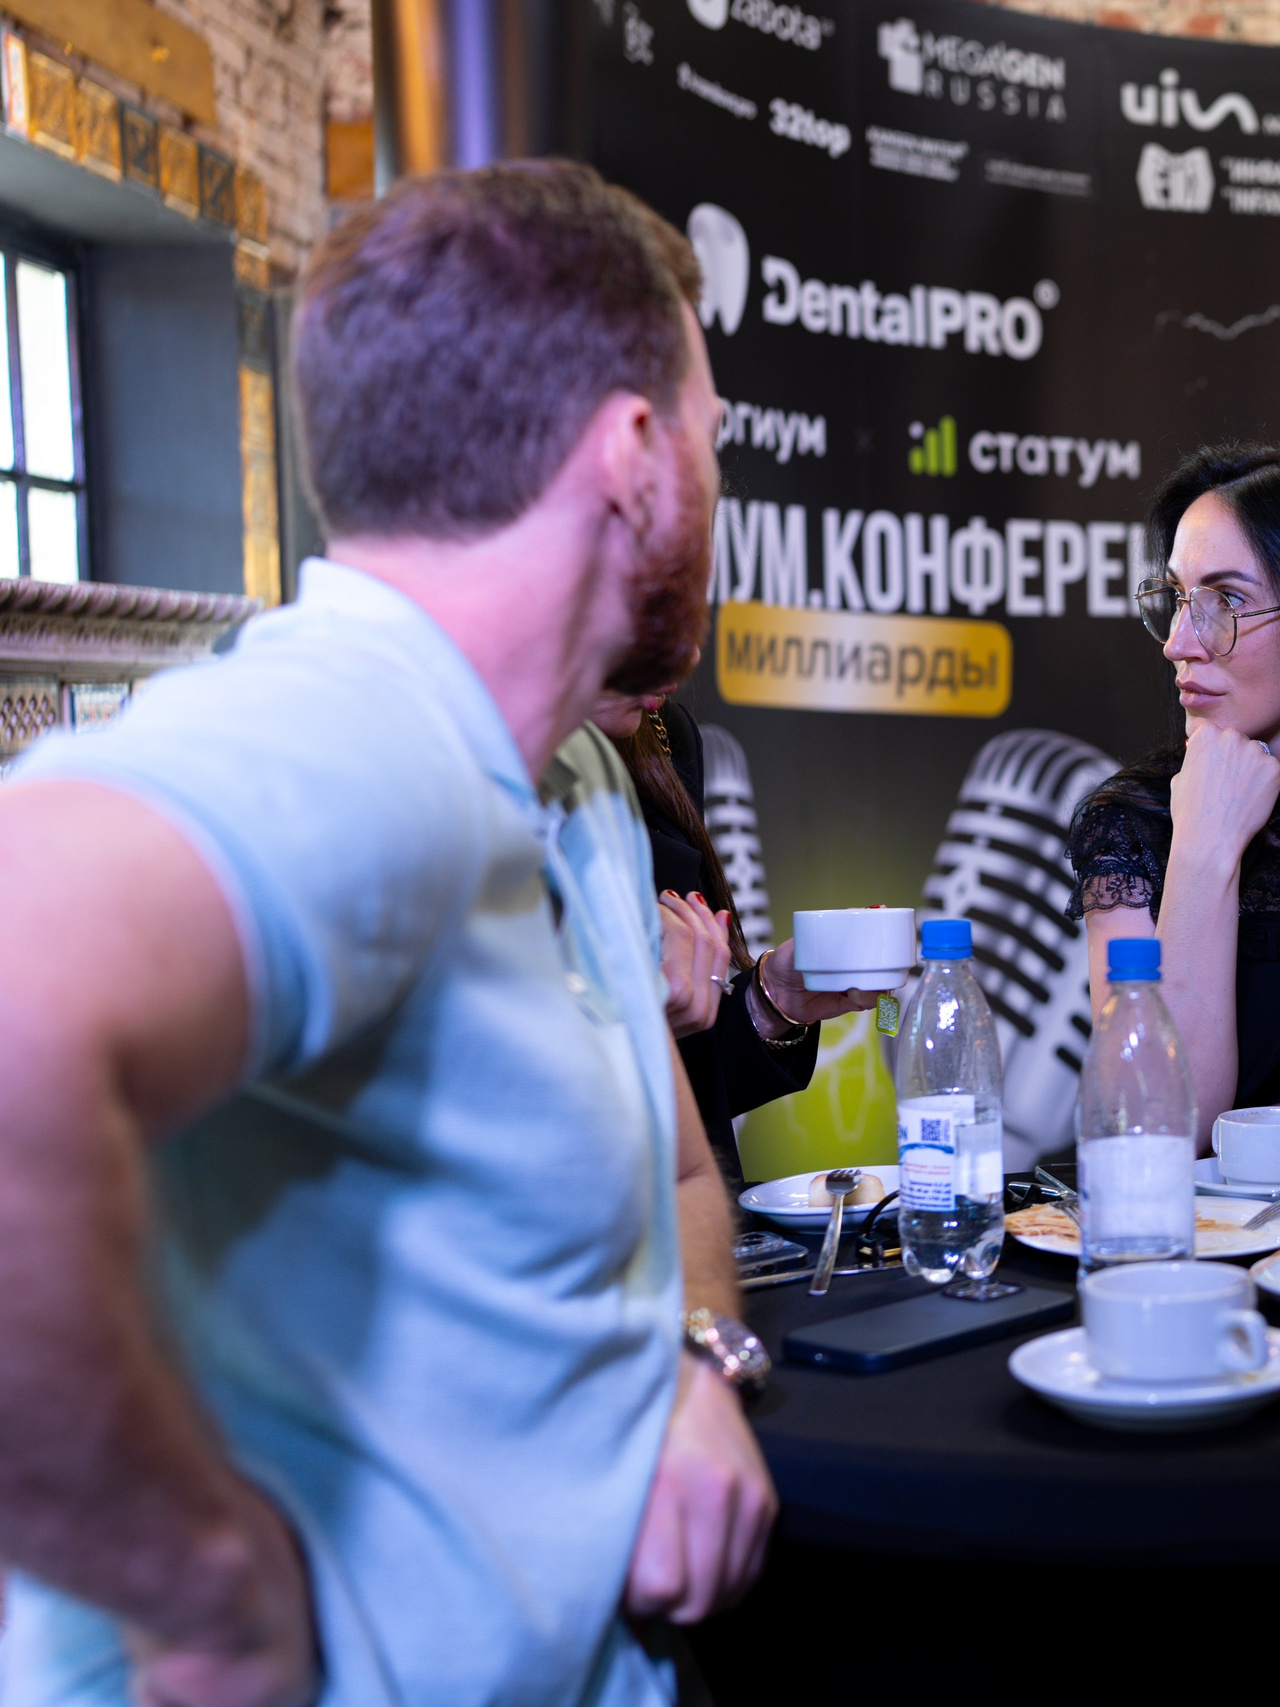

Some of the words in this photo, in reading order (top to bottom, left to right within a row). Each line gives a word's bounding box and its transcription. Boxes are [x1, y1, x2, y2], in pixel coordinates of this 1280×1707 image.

[922, 69, 1068, 123] RUSSIA
[768, 97, 852, 159] 32top
[967, 429, 1142, 488] статум
[725, 630, 998, 698] миллиарды
